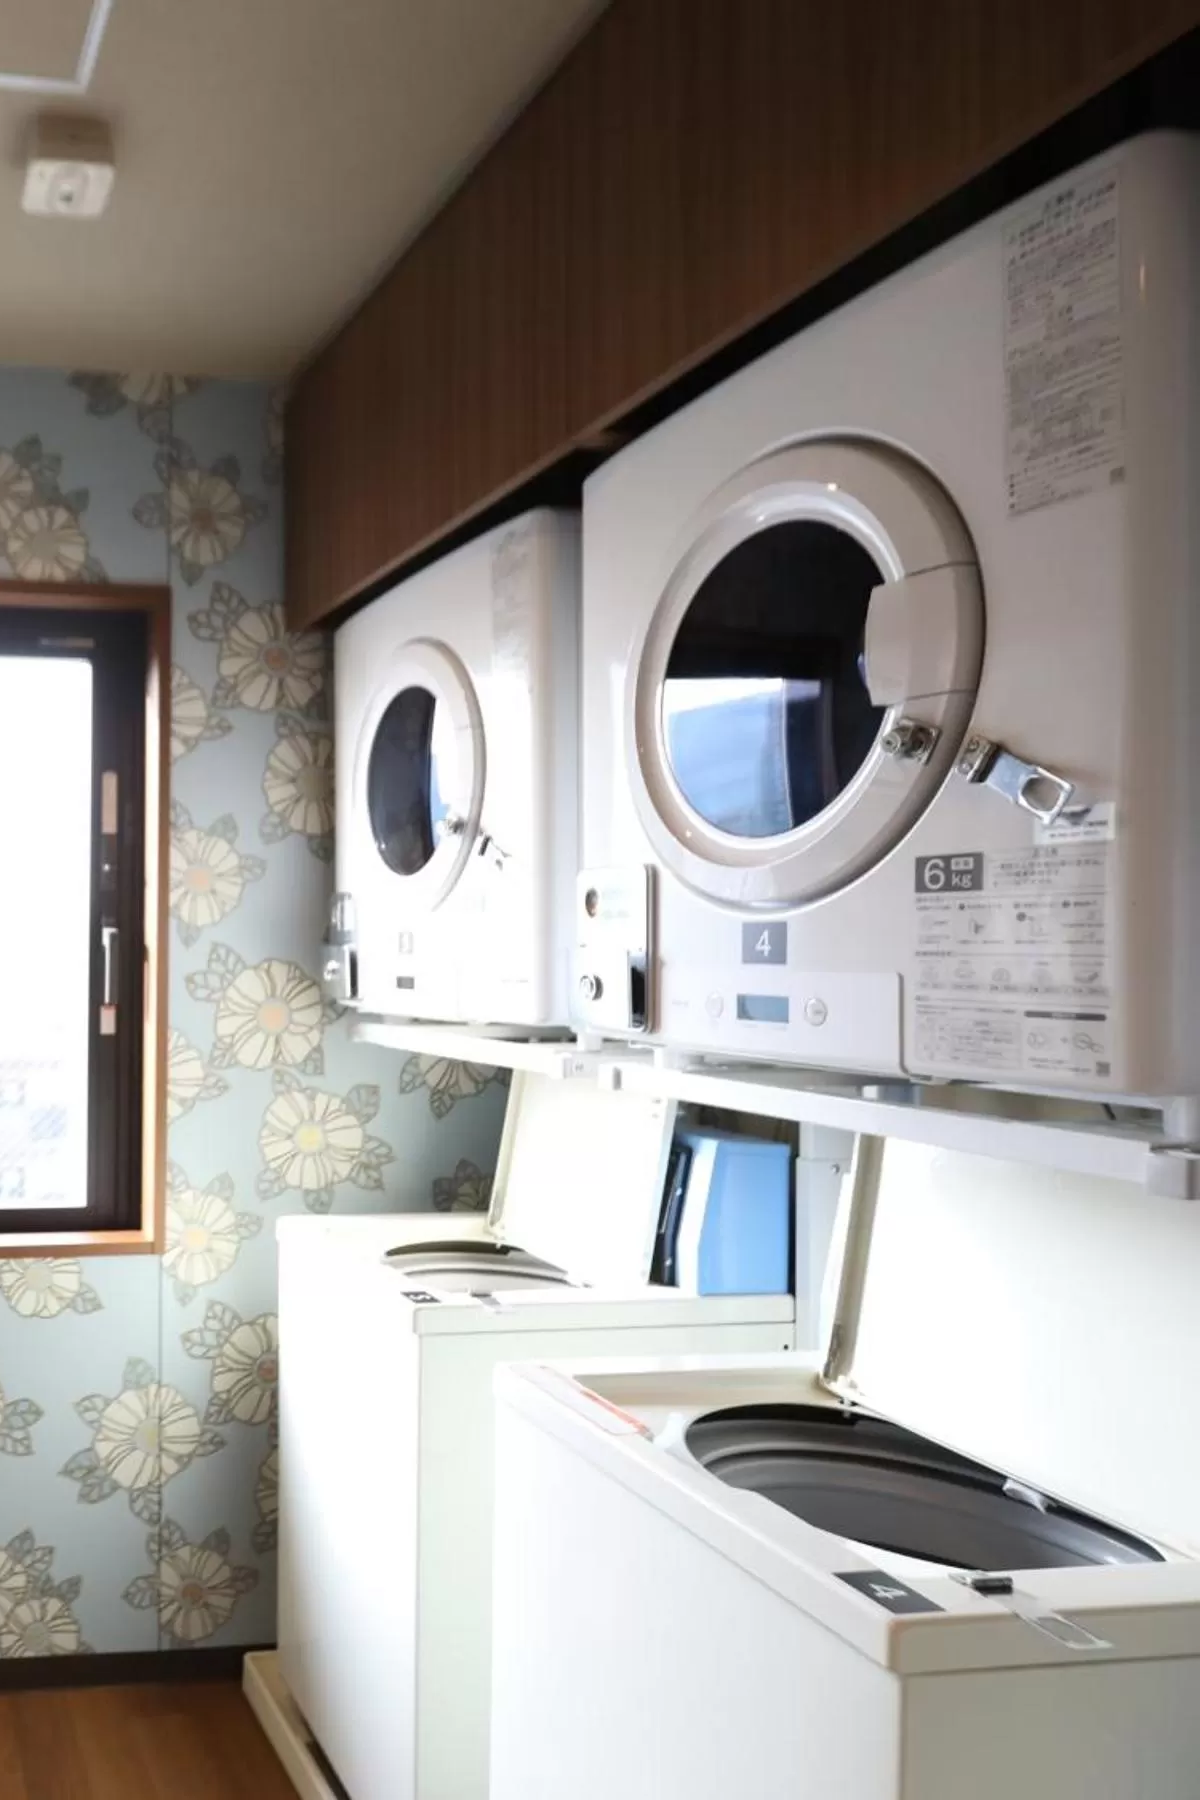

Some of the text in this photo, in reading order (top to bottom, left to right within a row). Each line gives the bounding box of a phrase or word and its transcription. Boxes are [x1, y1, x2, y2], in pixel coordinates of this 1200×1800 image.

[924, 858, 973, 890] 6 kg
[754, 929, 772, 957] 4
[868, 1583, 909, 1600] 4
